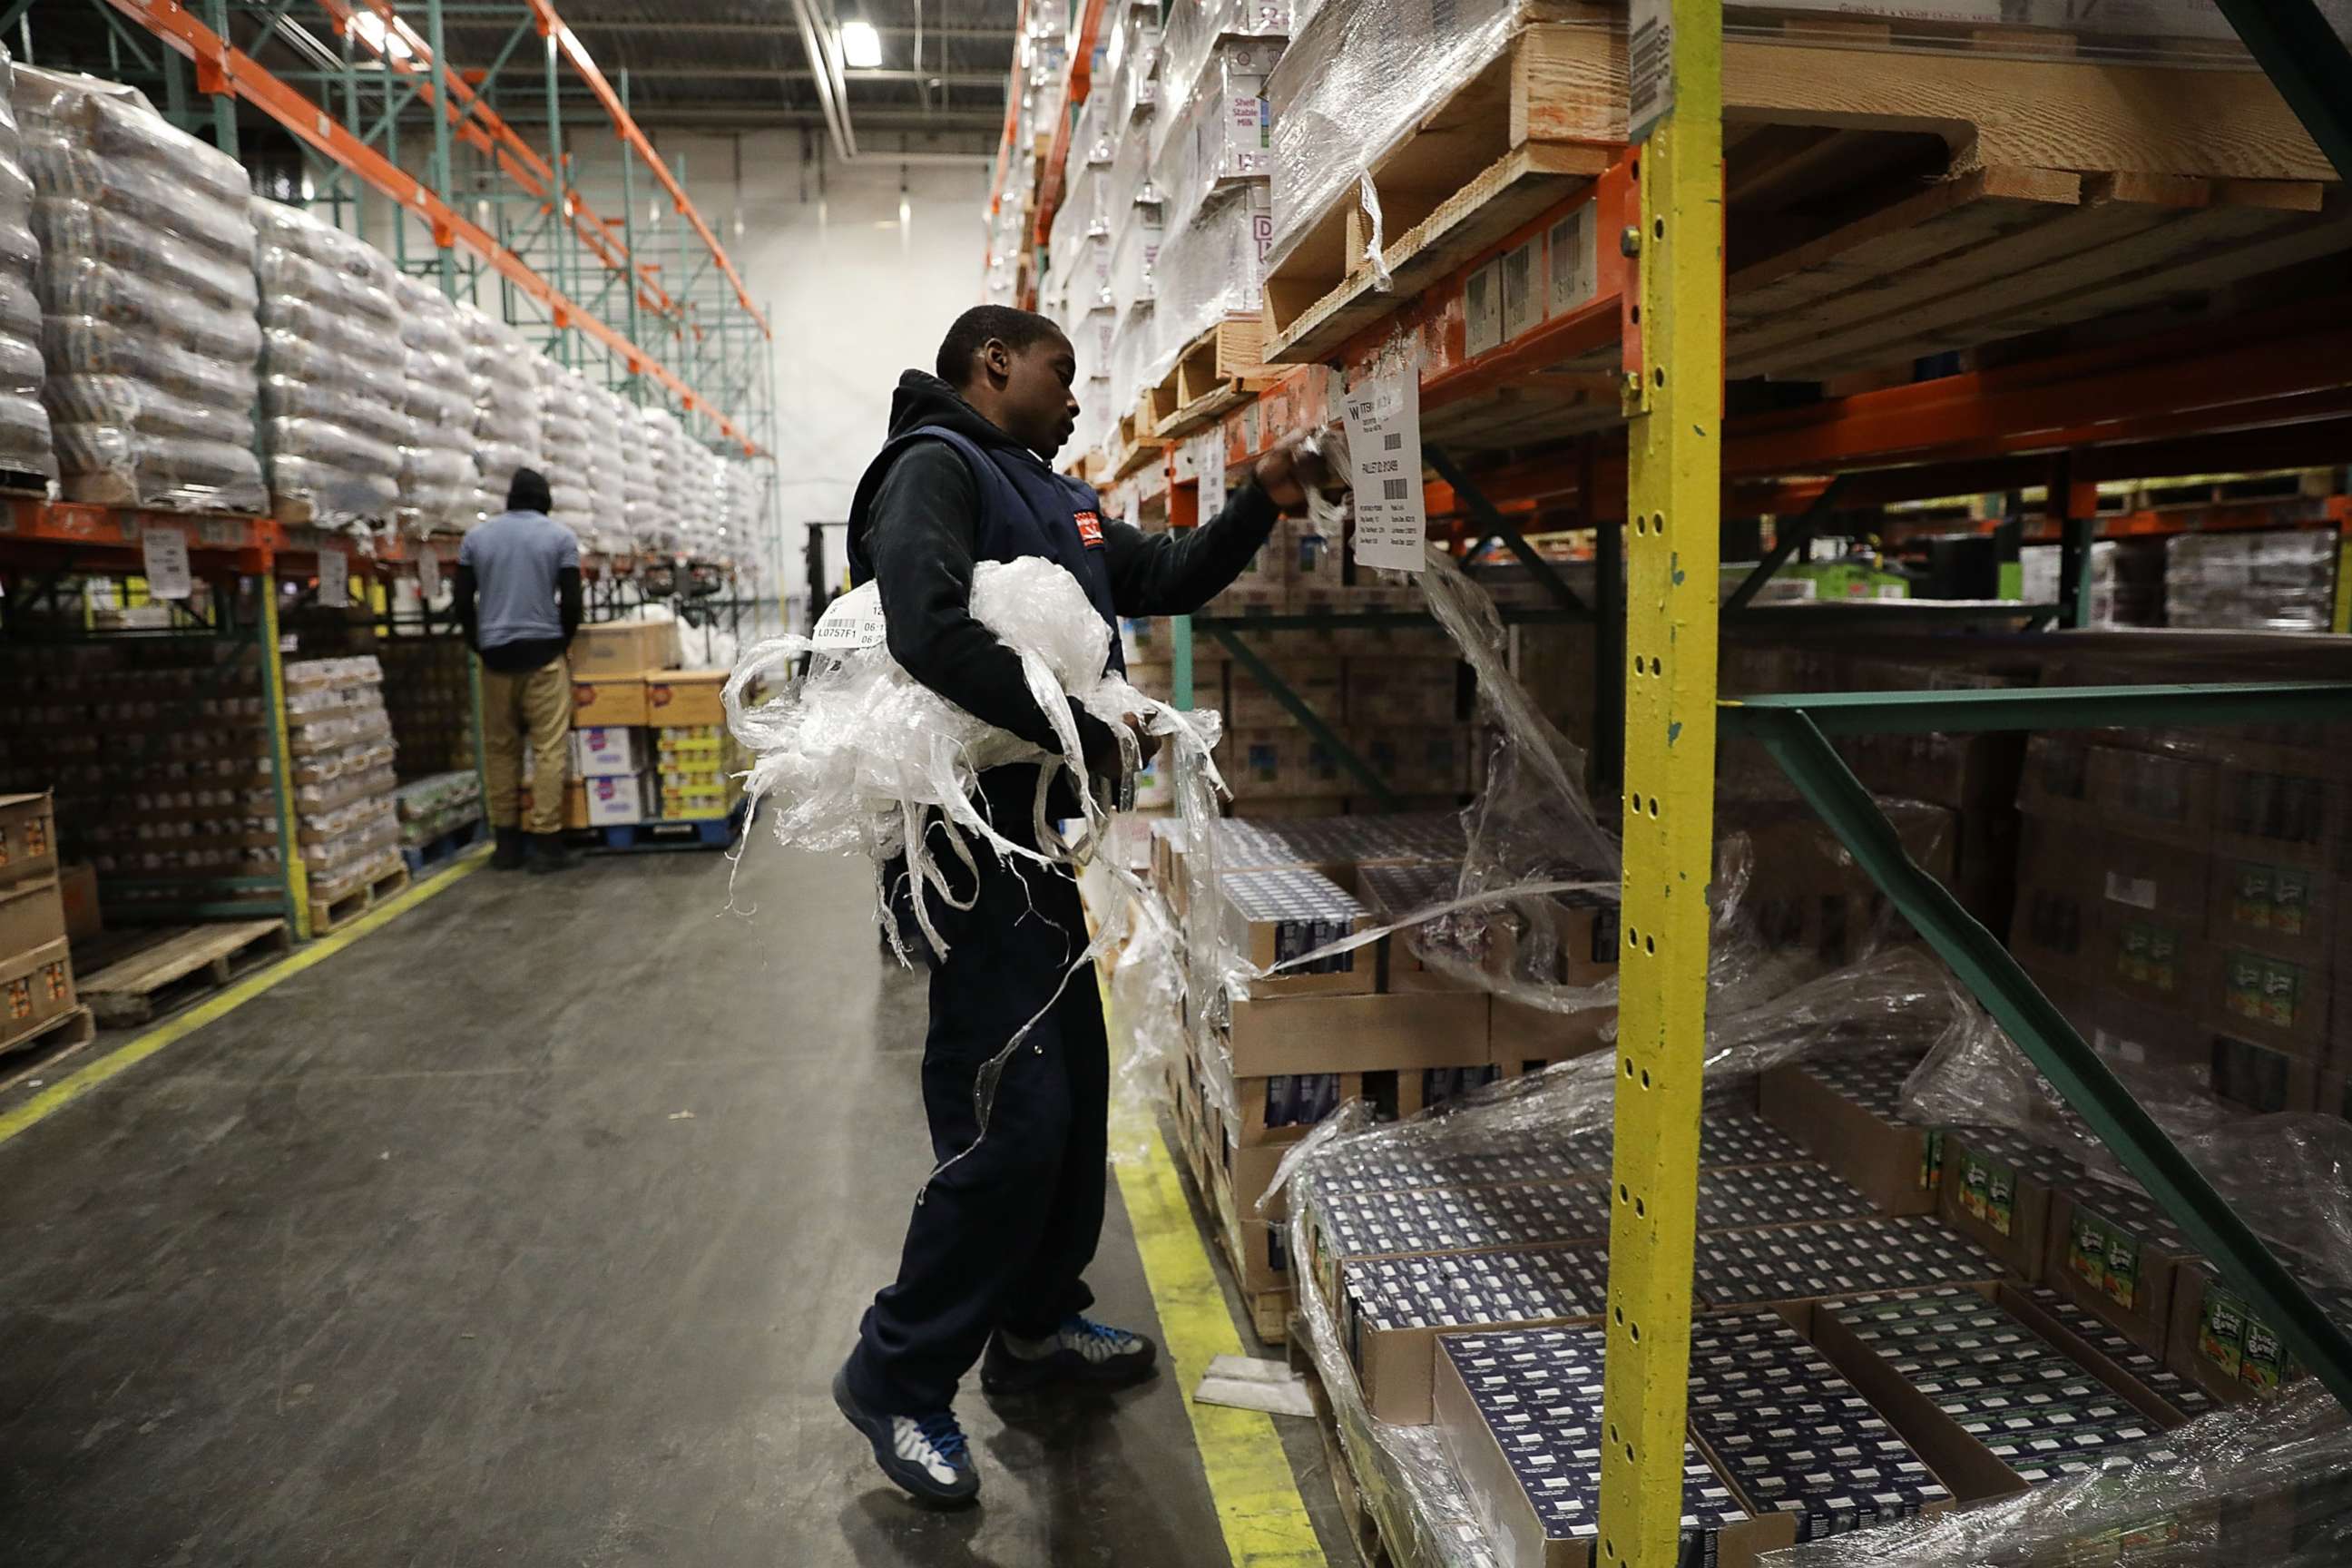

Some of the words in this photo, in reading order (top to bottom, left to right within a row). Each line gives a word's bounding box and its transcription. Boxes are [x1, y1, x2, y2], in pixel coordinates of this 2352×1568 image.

[1234, 97, 1256, 106] Shelf
[1233, 108, 1259, 117] Stable
[1237, 118, 1254, 126] Milk
